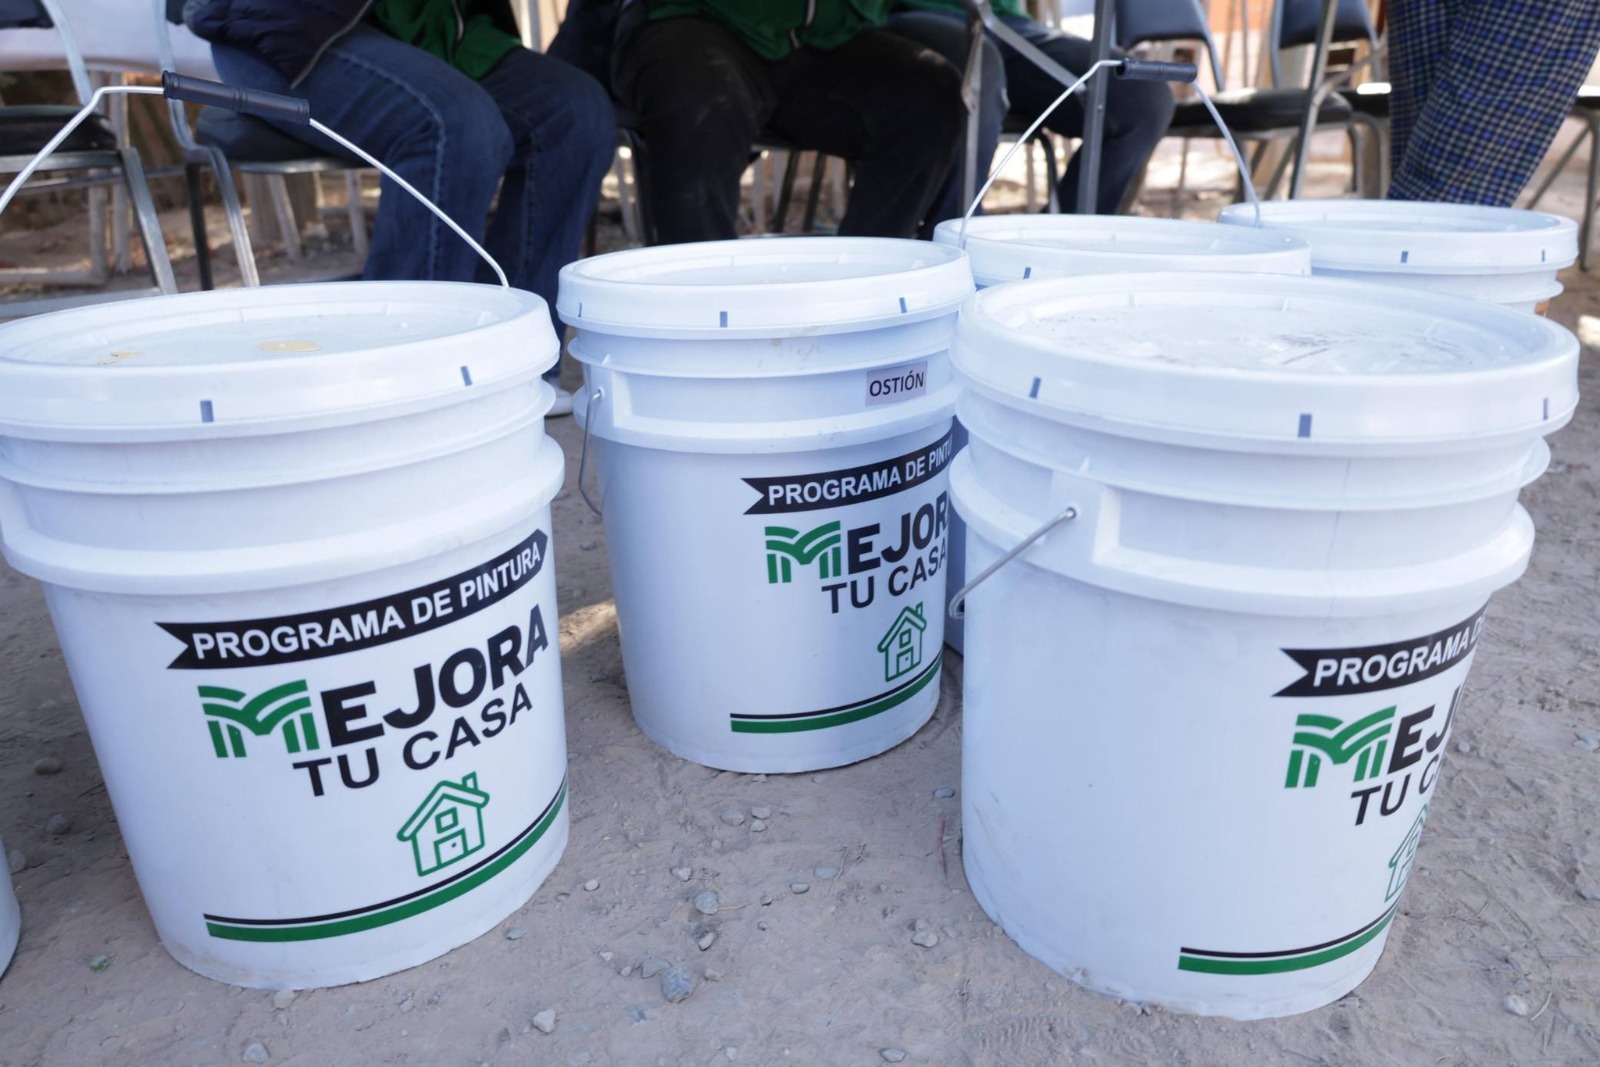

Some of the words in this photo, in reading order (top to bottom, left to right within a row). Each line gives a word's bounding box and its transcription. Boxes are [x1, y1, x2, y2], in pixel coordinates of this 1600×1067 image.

[869, 370, 924, 397] OSTIÓN
[768, 470, 901, 506] PROGRAMA
[905, 456, 926, 481] DE
[928, 436, 952, 472] PINTU
[764, 490, 948, 584] MEJOR
[821, 576, 875, 614] TU
[888, 537, 947, 597] CASA
[192, 609, 405, 659] PROGRAMA
[410, 588, 453, 621] DE
[459, 541, 541, 607] PINTURA
[197, 603, 549, 759] MEJORA
[1313, 626, 1471, 687] PROGRAMA
[292, 747, 381, 797] TU
[402, 682, 533, 770] CASA
[1284, 684, 1464, 788] MEJ
[1350, 773, 1412, 826] TU
